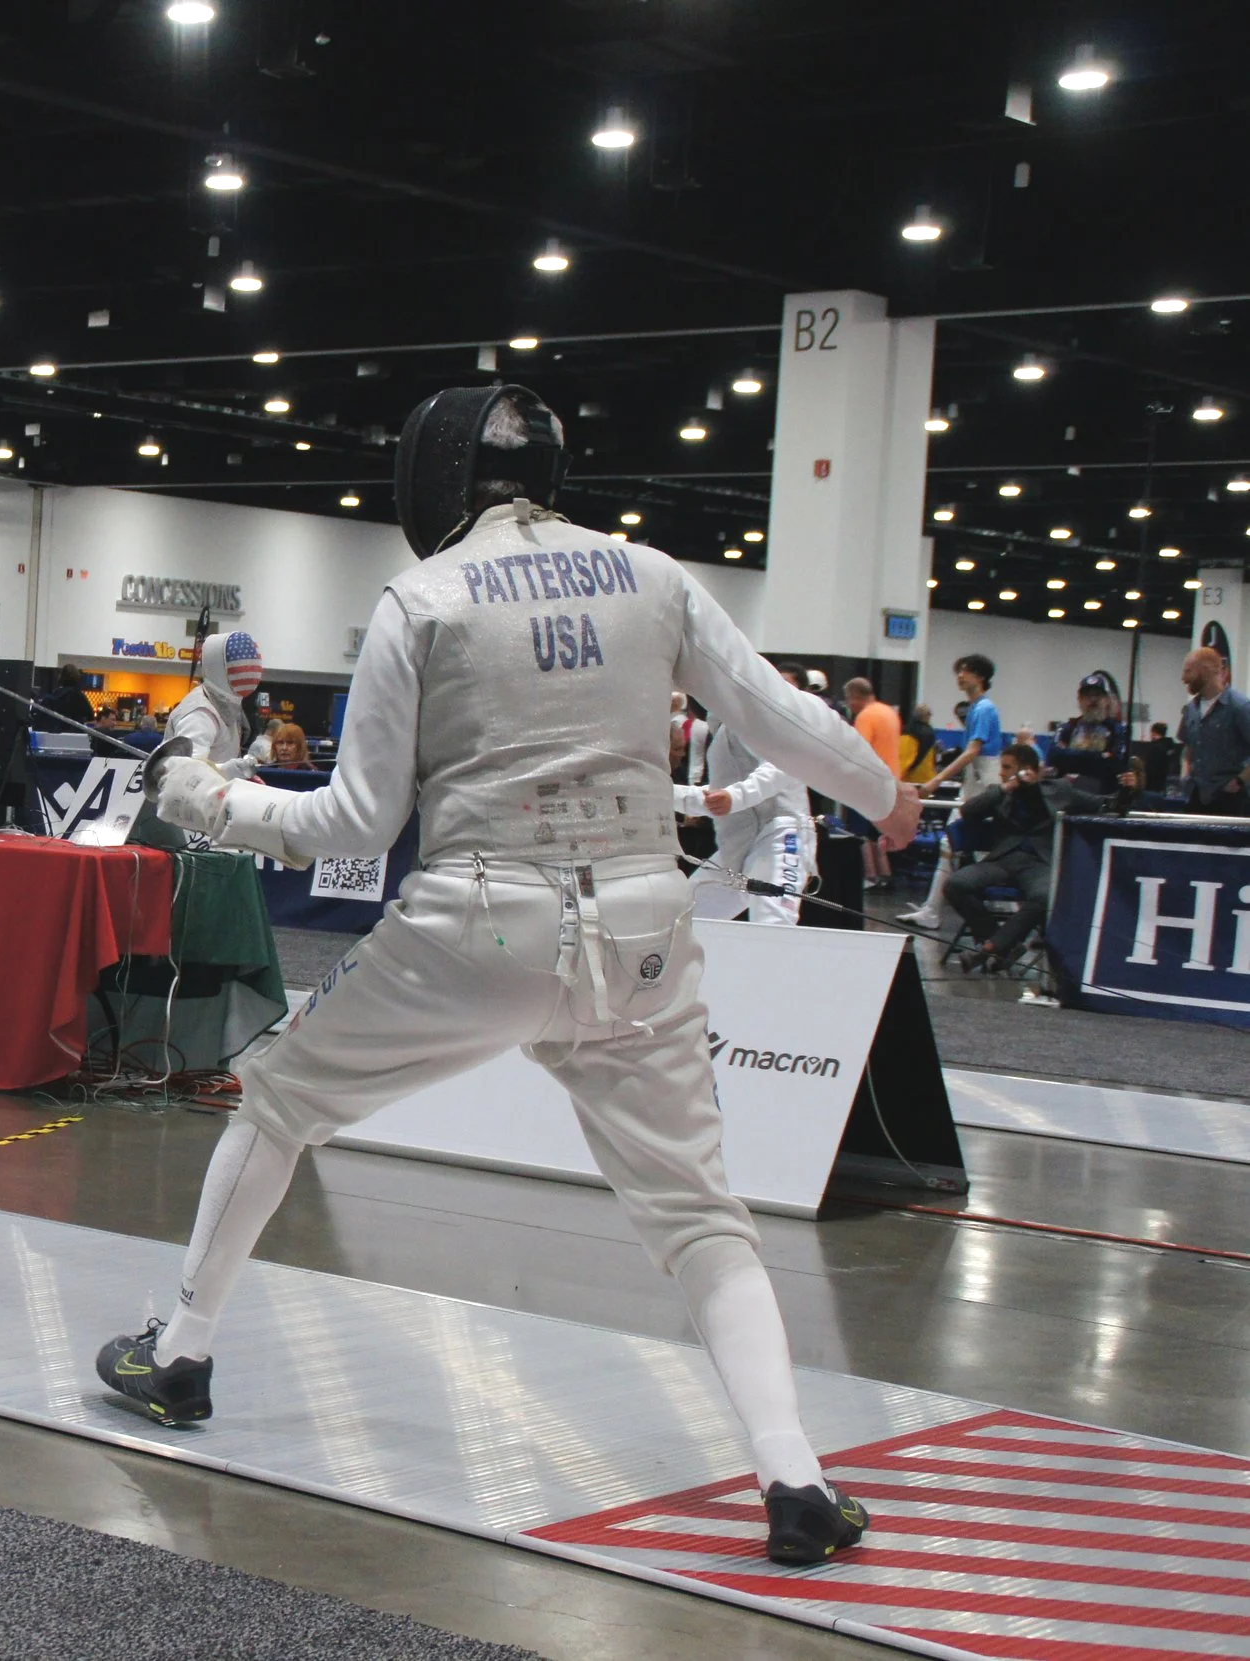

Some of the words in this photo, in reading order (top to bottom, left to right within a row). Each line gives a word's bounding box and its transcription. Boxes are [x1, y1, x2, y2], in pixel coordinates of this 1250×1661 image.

[795, 308, 840, 352] B2
[121, 574, 241, 610] CONCESSIONS
[461, 548, 638, 604] PATTERSON
[1202, 586, 1223, 606] E3
[530, 613, 604, 672] USA
[728, 1047, 841, 1078] macron
